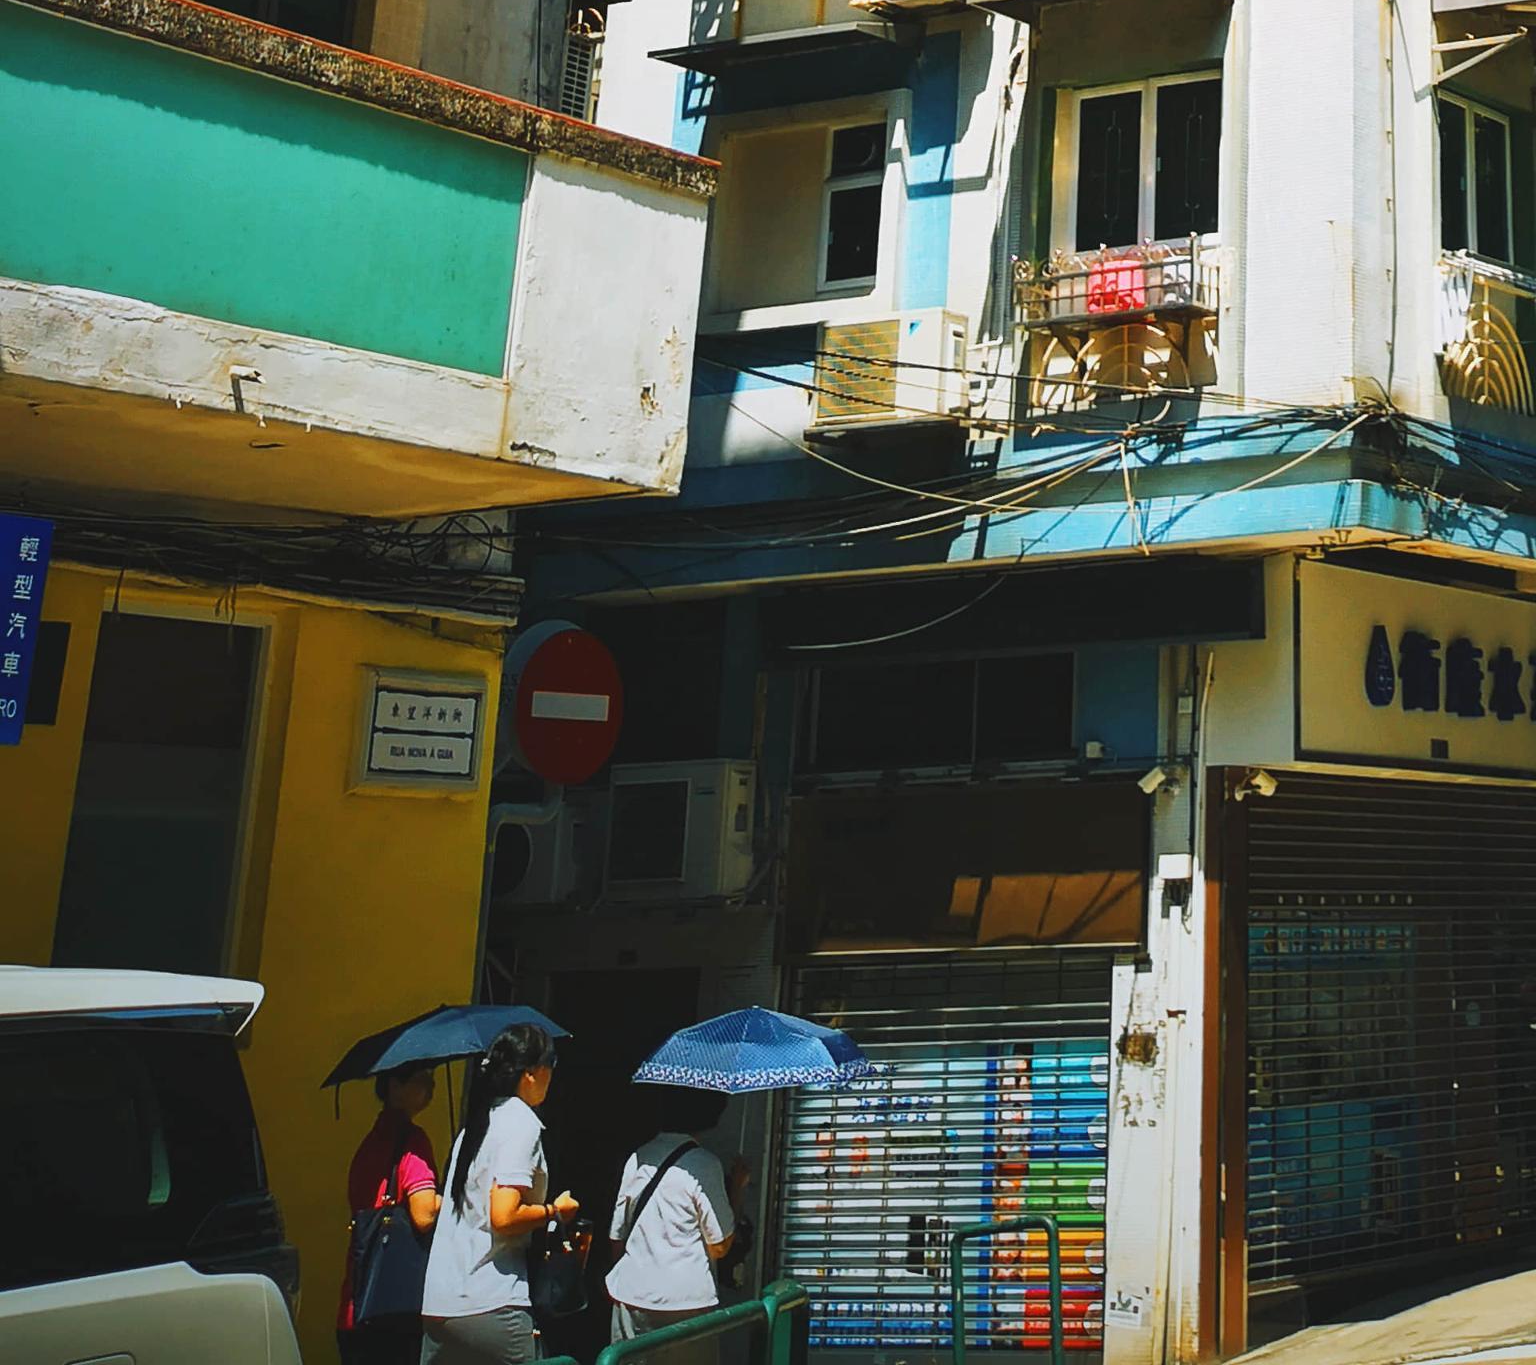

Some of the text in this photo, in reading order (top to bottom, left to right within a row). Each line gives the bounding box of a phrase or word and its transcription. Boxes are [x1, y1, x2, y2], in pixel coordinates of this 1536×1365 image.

[1, 536, 39, 678] 輕型汽車
[390, 745, 405, 758] RUA
[408, 746, 427, 758] NOVA
[437, 748, 453, 760] GUIA
